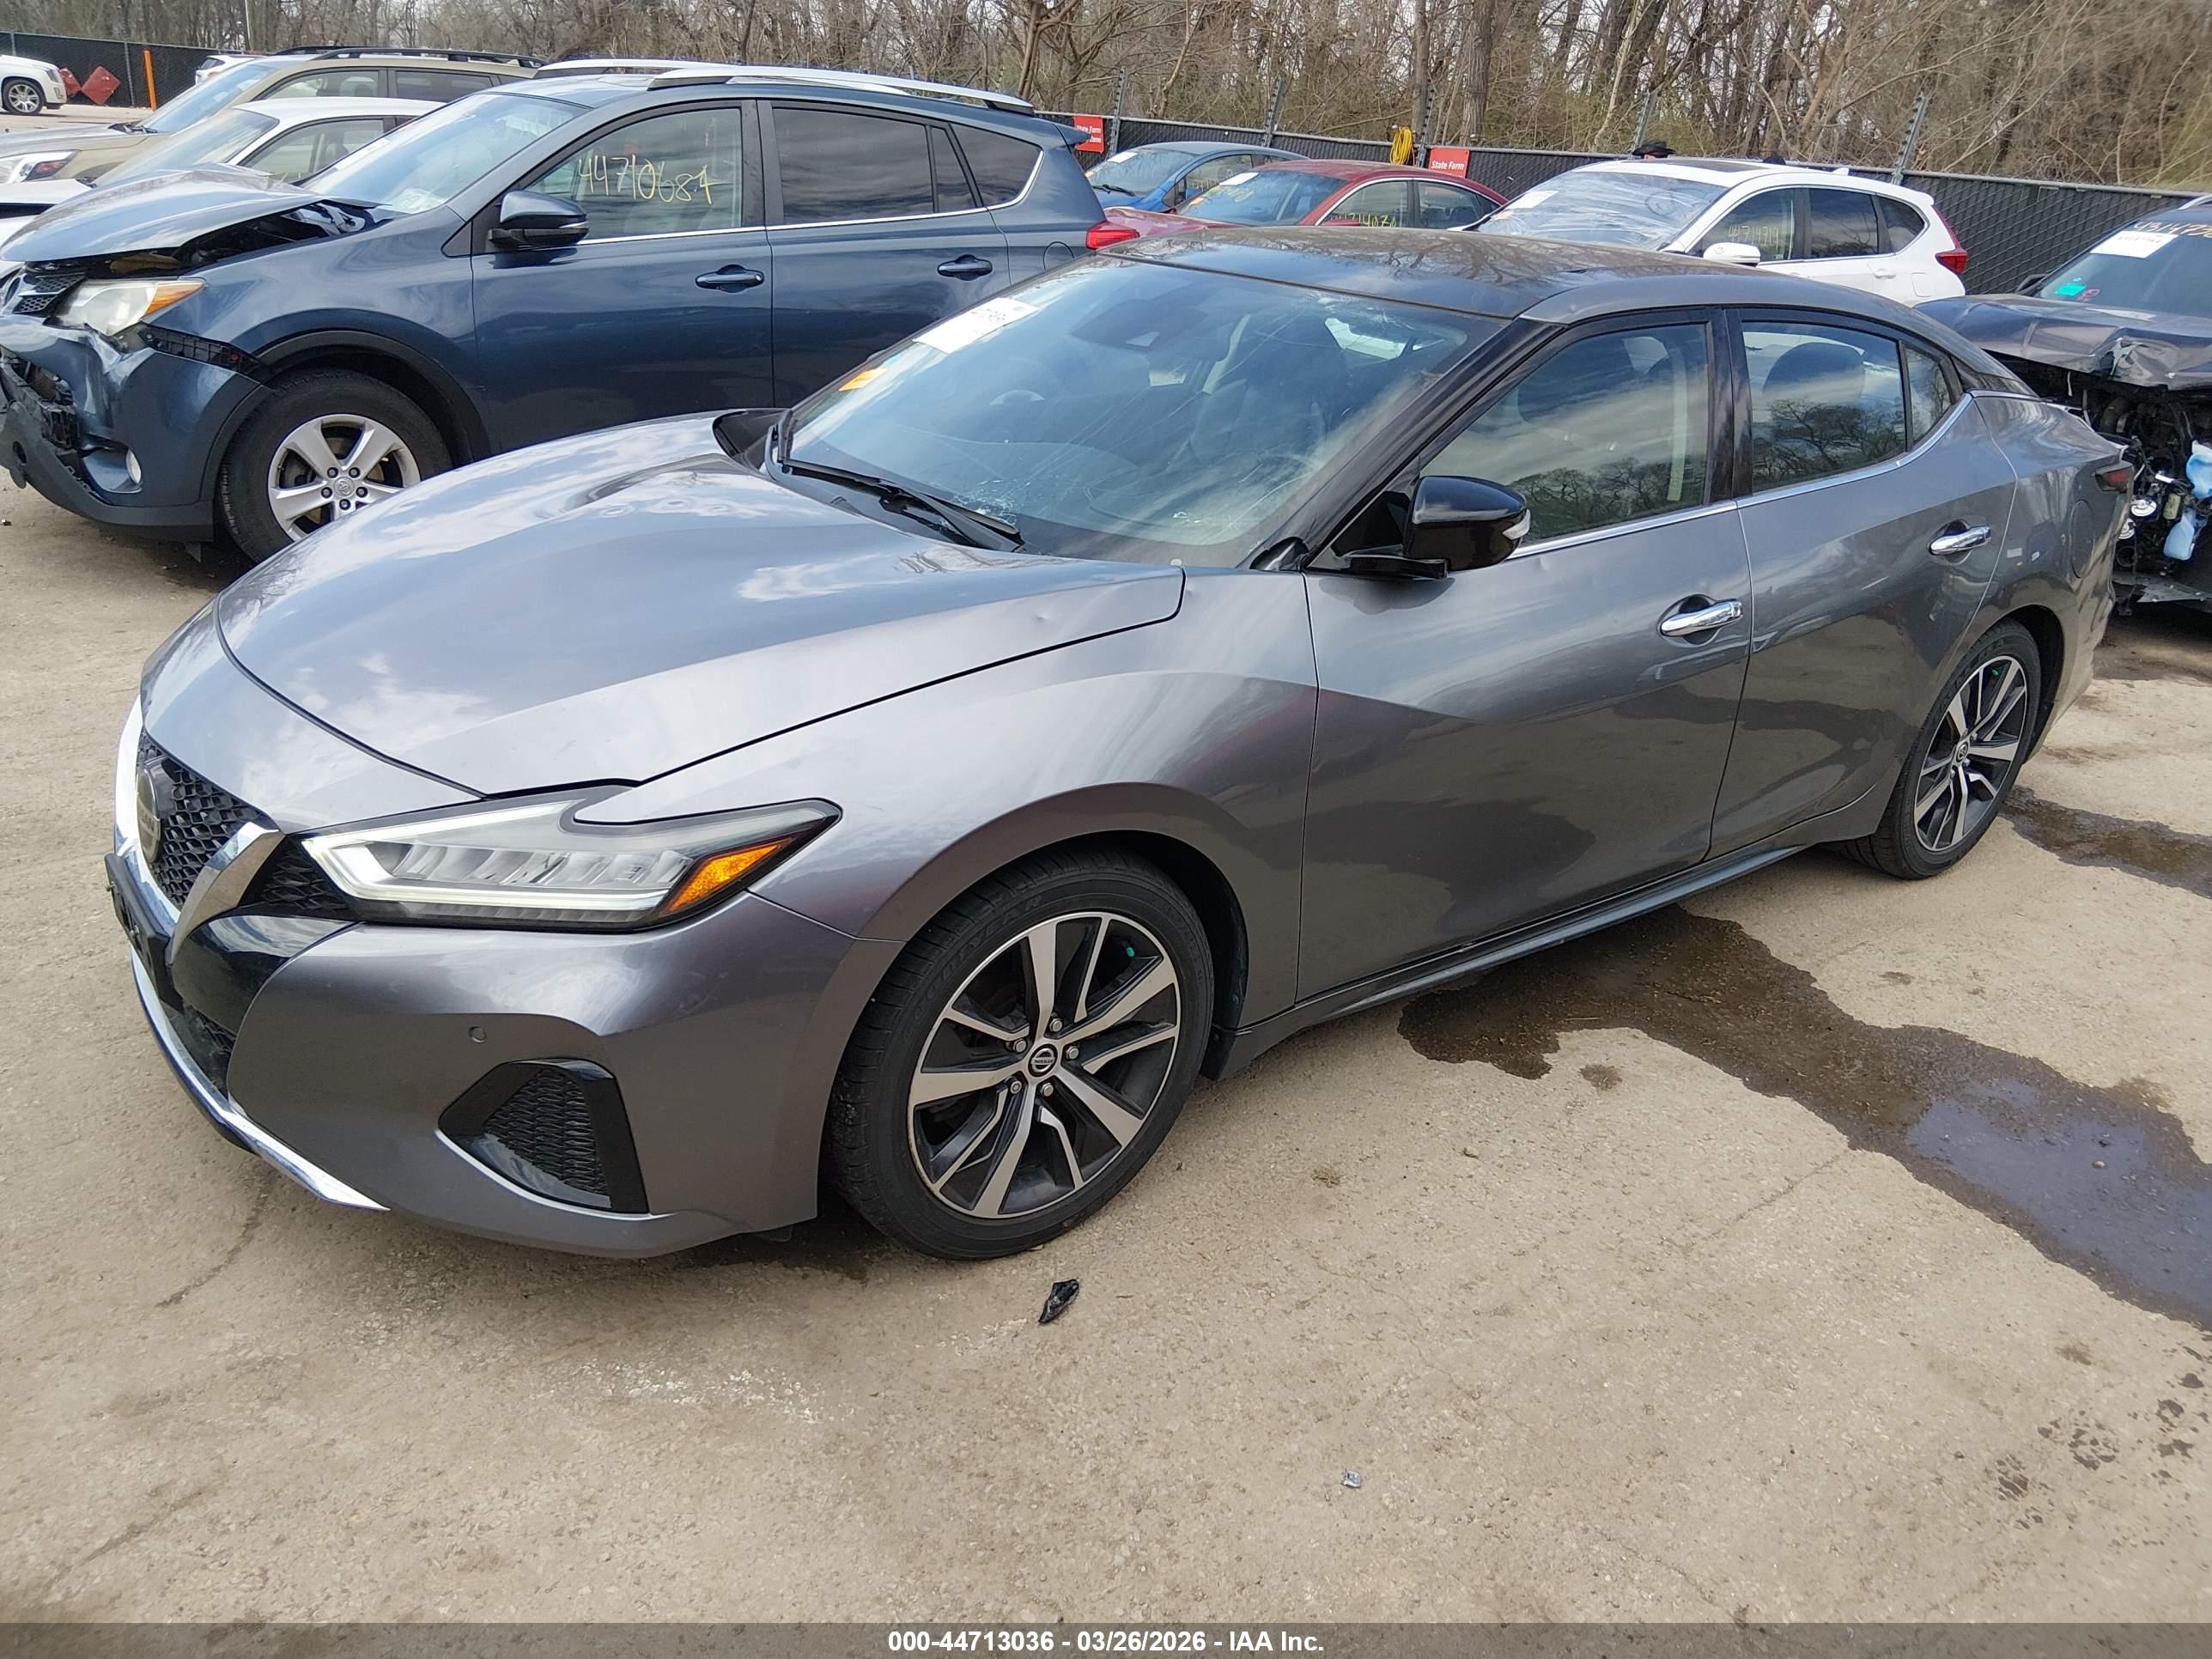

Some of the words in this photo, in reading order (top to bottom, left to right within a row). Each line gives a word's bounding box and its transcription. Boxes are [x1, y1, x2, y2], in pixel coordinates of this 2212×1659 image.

[1089, 125, 1101, 134] Farm
[1431, 161, 1448, 169] State
[1448, 161, 1465, 170] Farm
[578, 155, 722, 206] 44710684
